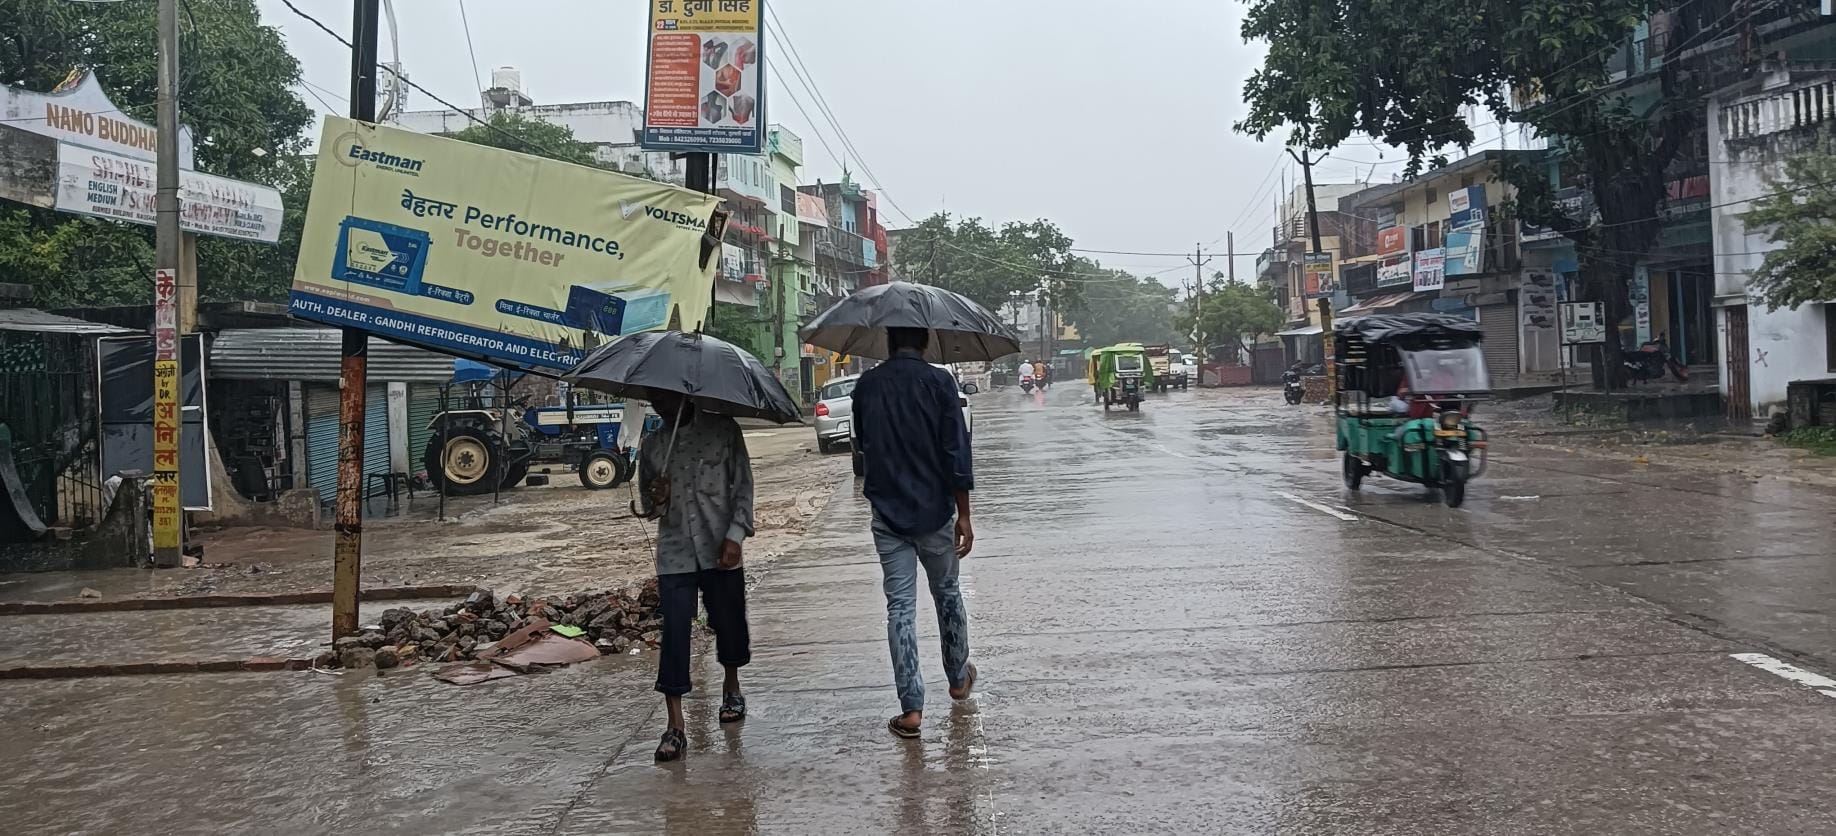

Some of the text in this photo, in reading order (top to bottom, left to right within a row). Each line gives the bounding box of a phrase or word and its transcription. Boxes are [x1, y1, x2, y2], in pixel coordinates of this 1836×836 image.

[46, 103, 94, 136] NAMO
[349, 144, 423, 172] Eastman
[87, 192, 117, 206] MEDIUM
[88, 180, 118, 195] ENGLISH
[400, 188, 625, 261] बेहतर Performance,
[454, 227, 565, 268] Together
[292, 299, 325, 314] AUTH.
[326, 306, 367, 323] DEALER
[374, 316, 416, 332] GANDHI
[417, 325, 504, 351] REFRIDGERATOR
[504, 344, 528, 355] AND
